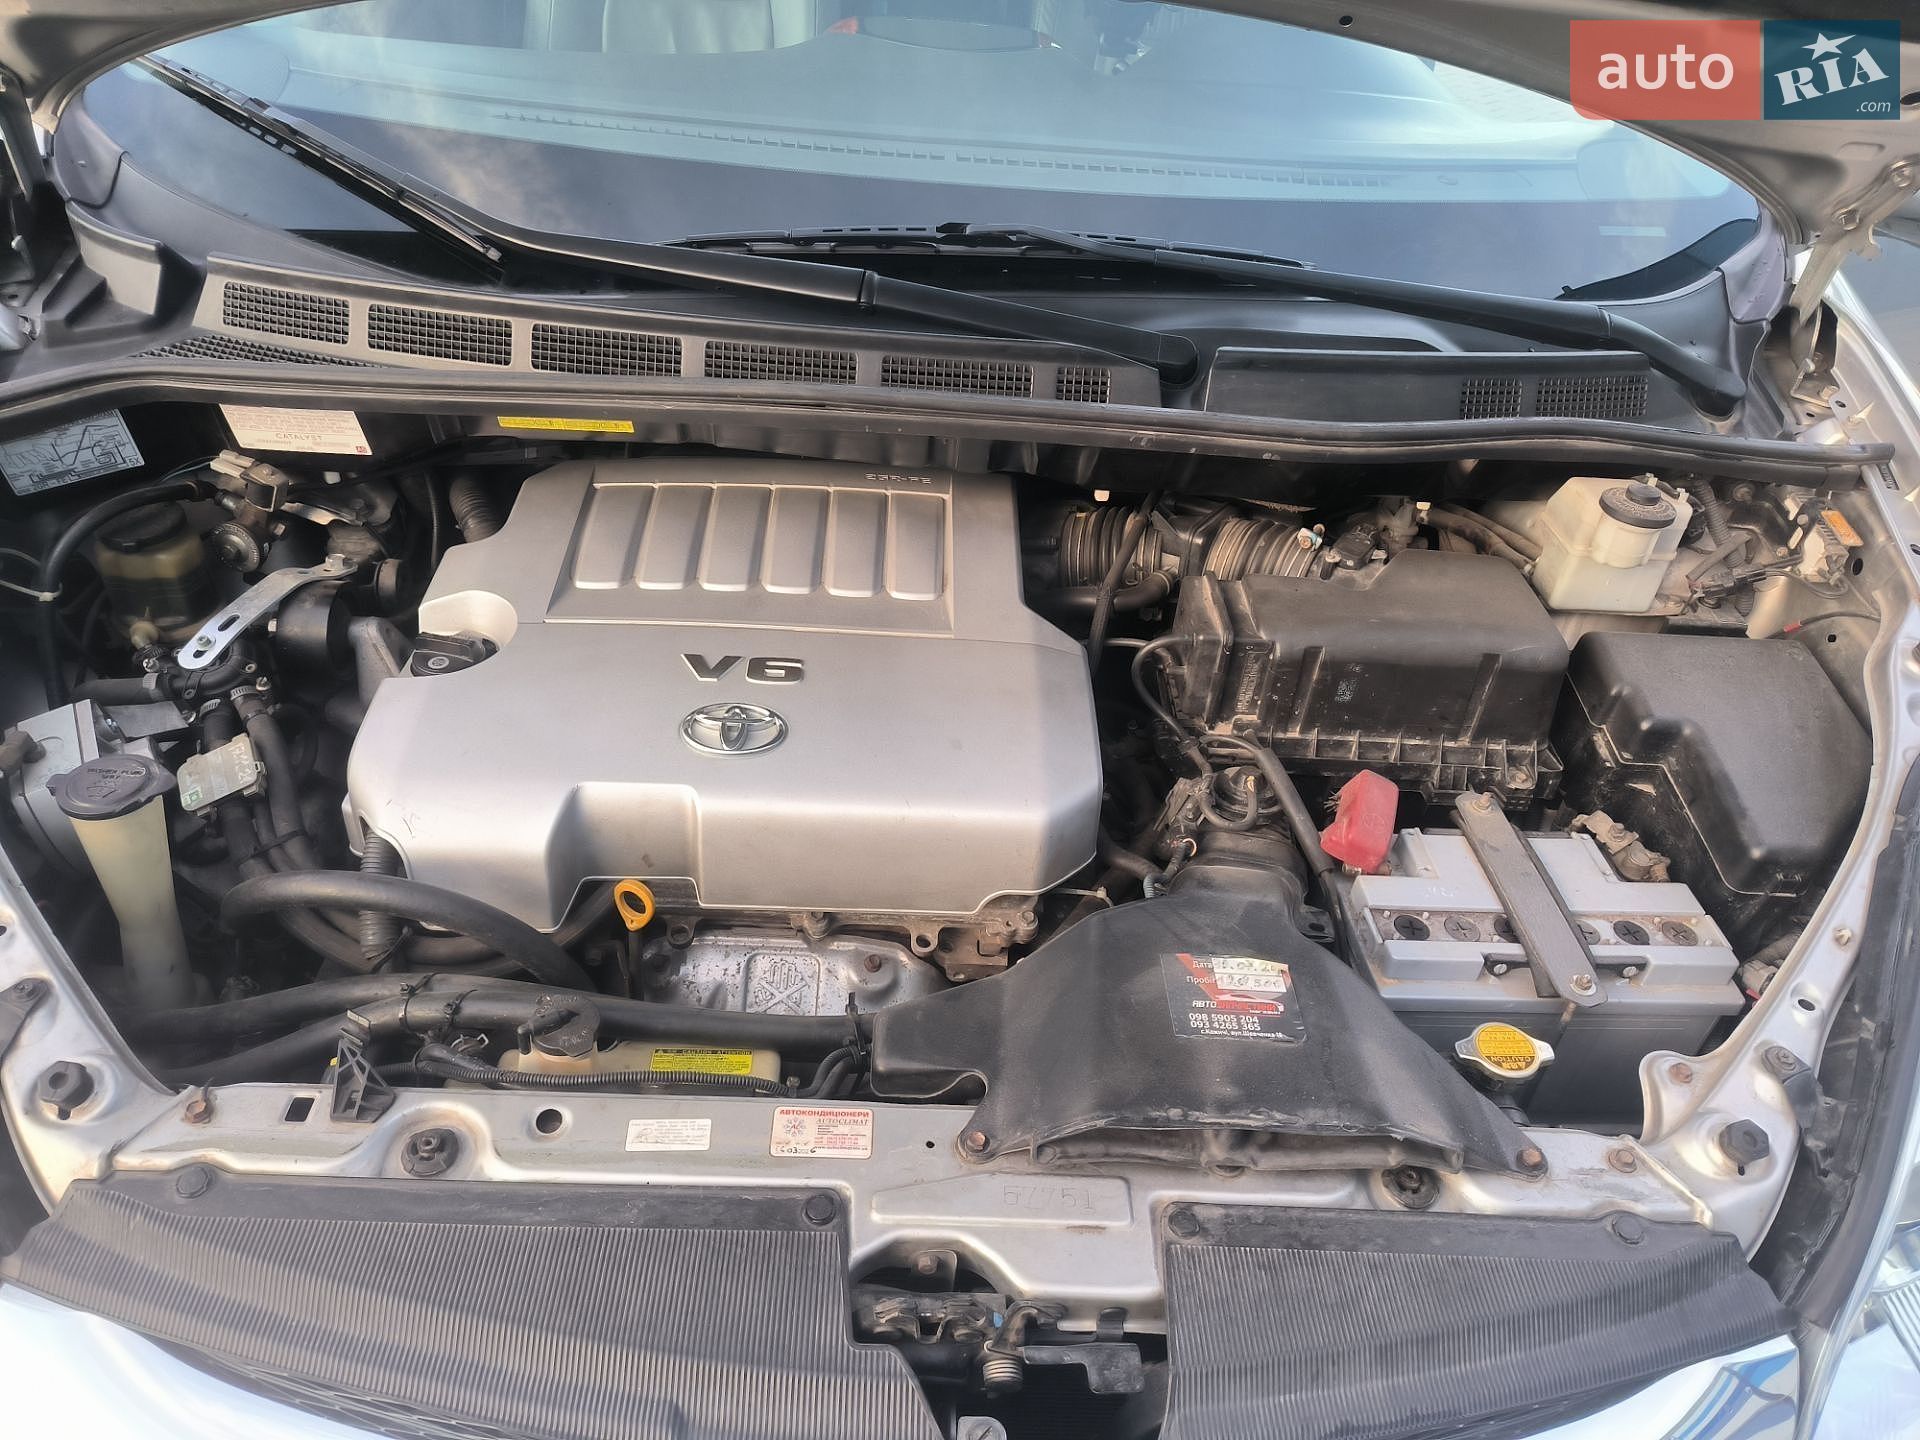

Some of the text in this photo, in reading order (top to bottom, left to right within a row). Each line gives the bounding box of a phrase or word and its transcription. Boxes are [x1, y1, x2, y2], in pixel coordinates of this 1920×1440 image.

[275, 432, 323, 441] CATALYST
[681, 653, 804, 685] V6
[1189, 1013, 1259, 1023] 098 5905 204
[1190, 1020, 1261, 1031] 093 4265 365
